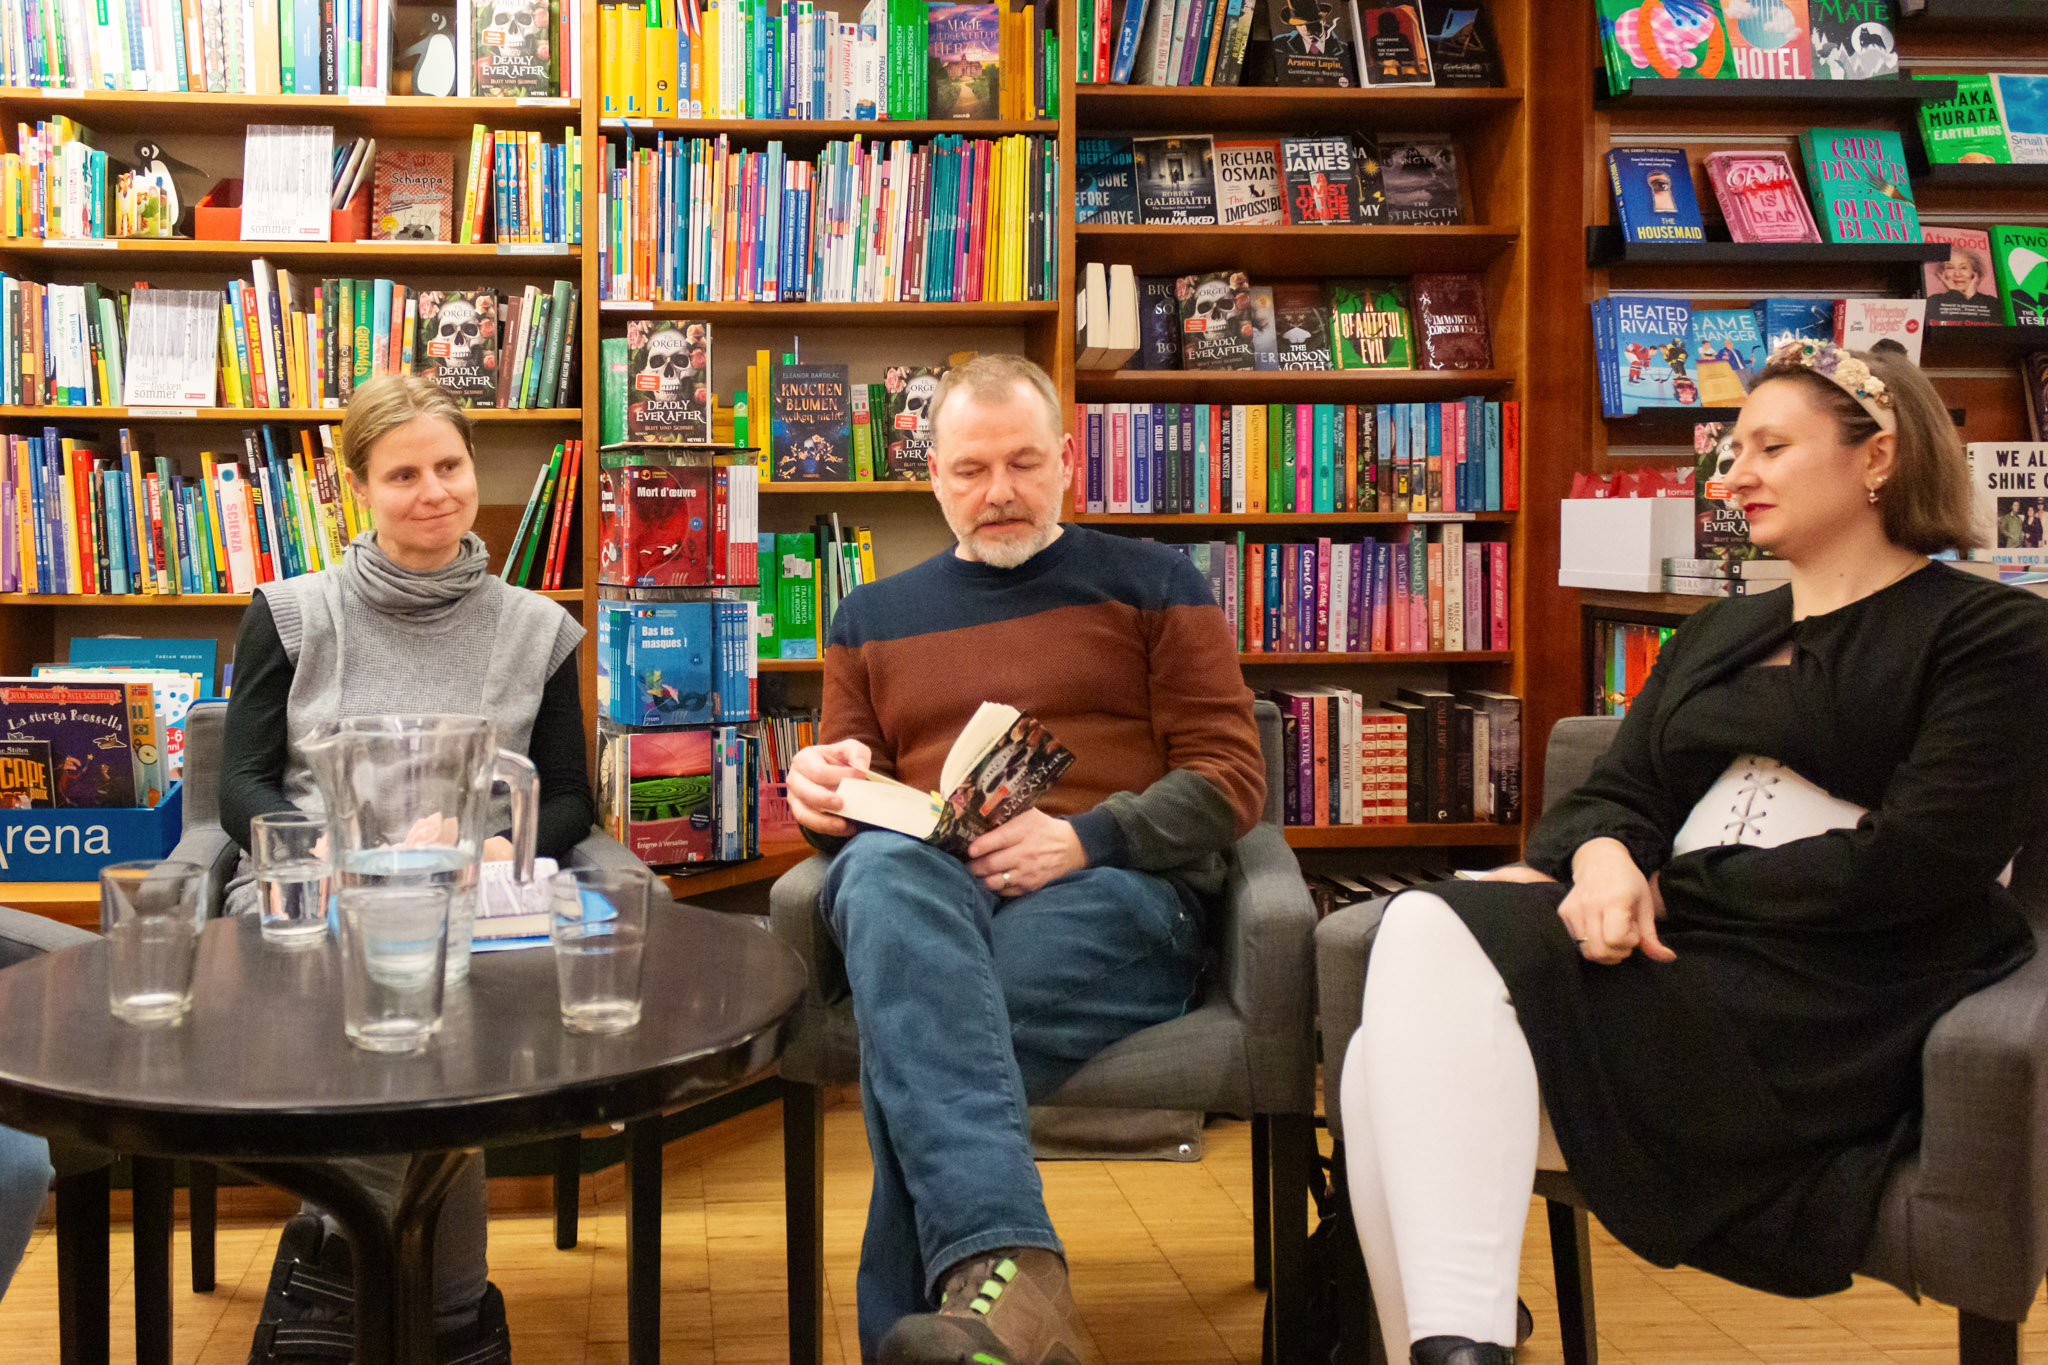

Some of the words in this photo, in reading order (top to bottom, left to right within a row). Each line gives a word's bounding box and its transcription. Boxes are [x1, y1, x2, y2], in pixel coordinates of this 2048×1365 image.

[1818, 0, 1889, 22] MATE
[492, 55, 533, 67] DEADLY
[1733, 47, 1806, 79] HOTEL
[481, 65, 516, 78] EVER
[508, 66, 549, 78] AFTER
[680, 62, 688, 88] French
[692, 64, 700, 89] French
[1929, 108, 1999, 128] MURATA
[1934, 125, 2003, 141] EARTHLINGS
[2010, 135, 2043, 146] Small
[1285, 142, 1347, 157] PETER
[1831, 138, 1891, 166] GIRL
[1075, 152, 1132, 165] THERSPOON
[1221, 151, 1275, 167] RICHAR
[1285, 157, 1351, 172] JAMES
[1097, 172, 1128, 187] GONE
[1315, 173, 1329, 185] A
[1820, 158, 1908, 187] DINNER
[390, 173, 443, 190] Schiappa
[1161, 190, 1194, 199] ROBERT
[1297, 184, 1347, 197] TWIST
[1075, 191, 1110, 206] EFORE
[1145, 196, 1212, 208] GALBRAITH
[1296, 196, 1313, 209] OF
[1312, 196, 1349, 209] THE
[1761, 194, 1777, 209] IS
[1078, 210, 1135, 225] GOODBYE
[1172, 210, 1188, 219] THE
[1224, 198, 1282, 223] IMPOSS!BL
[1302, 207, 1350, 221] KNIFE
[1387, 207, 1459, 222] STRENGTH
[1750, 209, 1796, 225] DEAD
[1832, 198, 1912, 224] OLIVIE
[250, 223, 292, 234] sommer
[1145, 216, 1216, 226] HALLMARKED
[1661, 217, 1676, 225] THE
[1637, 226, 1702, 240] HOUSEMAID
[1837, 219, 1917, 243] BLAKE
[1924, 232, 1988, 250] Atwood
[2003, 234, 2048, 248] ATWO
[1618, 305, 1688, 323] HEATED
[1340, 311, 1404, 338] BEAUTIFUL
[1618, 320, 1688, 338] RIVALRY
[1695, 328, 1757, 342] HANGER
[652, 339, 687, 350] ORGEL
[1197, 336, 1239, 350] DEADLY
[1290, 344, 1307, 352] THE
[1360, 338, 1388, 363] EVIL
[353, 325, 372, 378] GREENWILD
[1188, 348, 1221, 361] EVER
[1216, 343, 1257, 361] AFTER
[1280, 349, 1331, 362] RIMSON
[438, 366, 480, 376] DEADLY
[458, 376, 495, 389] AFTER
[781, 383, 843, 397] KNOCHEN
[910, 384, 935, 394] ORGE
[134, 388, 177, 399] sommer
[647, 400, 690, 411] DEADLY
[787, 398, 839, 411] BLUMEN
[636, 411, 674, 424] EVER
[666, 410, 708, 424] AFTER
[1221, 420, 1230, 435] MAKE
[905, 439, 934, 450] DEAD
[895, 449, 929, 462] EVER
[1995, 450, 2020, 467] WE
[2027, 450, 2048, 467] AL
[1222, 452, 1230, 479] MONSTER
[1987, 472, 2037, 490] SHINE
[637, 487, 660, 498] Mort
[660, 486, 698, 498] d'œuvre
[1666, 488, 1695, 497] tonies
[1715, 510, 1747, 522] DEA
[225, 503, 242, 553] SCIENZA
[1703, 520, 1748, 537] EVER
[1336, 550, 1344, 567] KATE
[2018, 555, 2041, 564] YOKO
[1302, 550, 1315, 583] Game
[1397, 554, 1409, 598] REWITCHED
[1303, 584, 1313, 600] On
[1335, 571, 1343, 603] STEWART
[800, 586, 808, 625] ITALIENISCH
[1446, 604, 1454, 630] YARROS
[1453, 602, 1461, 632] REBECCA
[642, 626, 658, 637] Bas
[660, 626, 675, 636] les
[641, 639, 683, 649] masques
[1300, 702, 1311, 720] BEST
[7, 718, 27, 731] La
[29, 710, 67, 727] strega
[70, 708, 123, 732] Rossella
[1300, 724, 1311, 741] HEX
[1300, 743, 1311, 767] EVER
[1364, 725, 1376, 800] LEGENDARY
[1379, 725, 1391, 800] LEGENDARY
[0, 758, 48, 790] CAPE
[1343, 743, 1351, 790] SPECTACULAR
